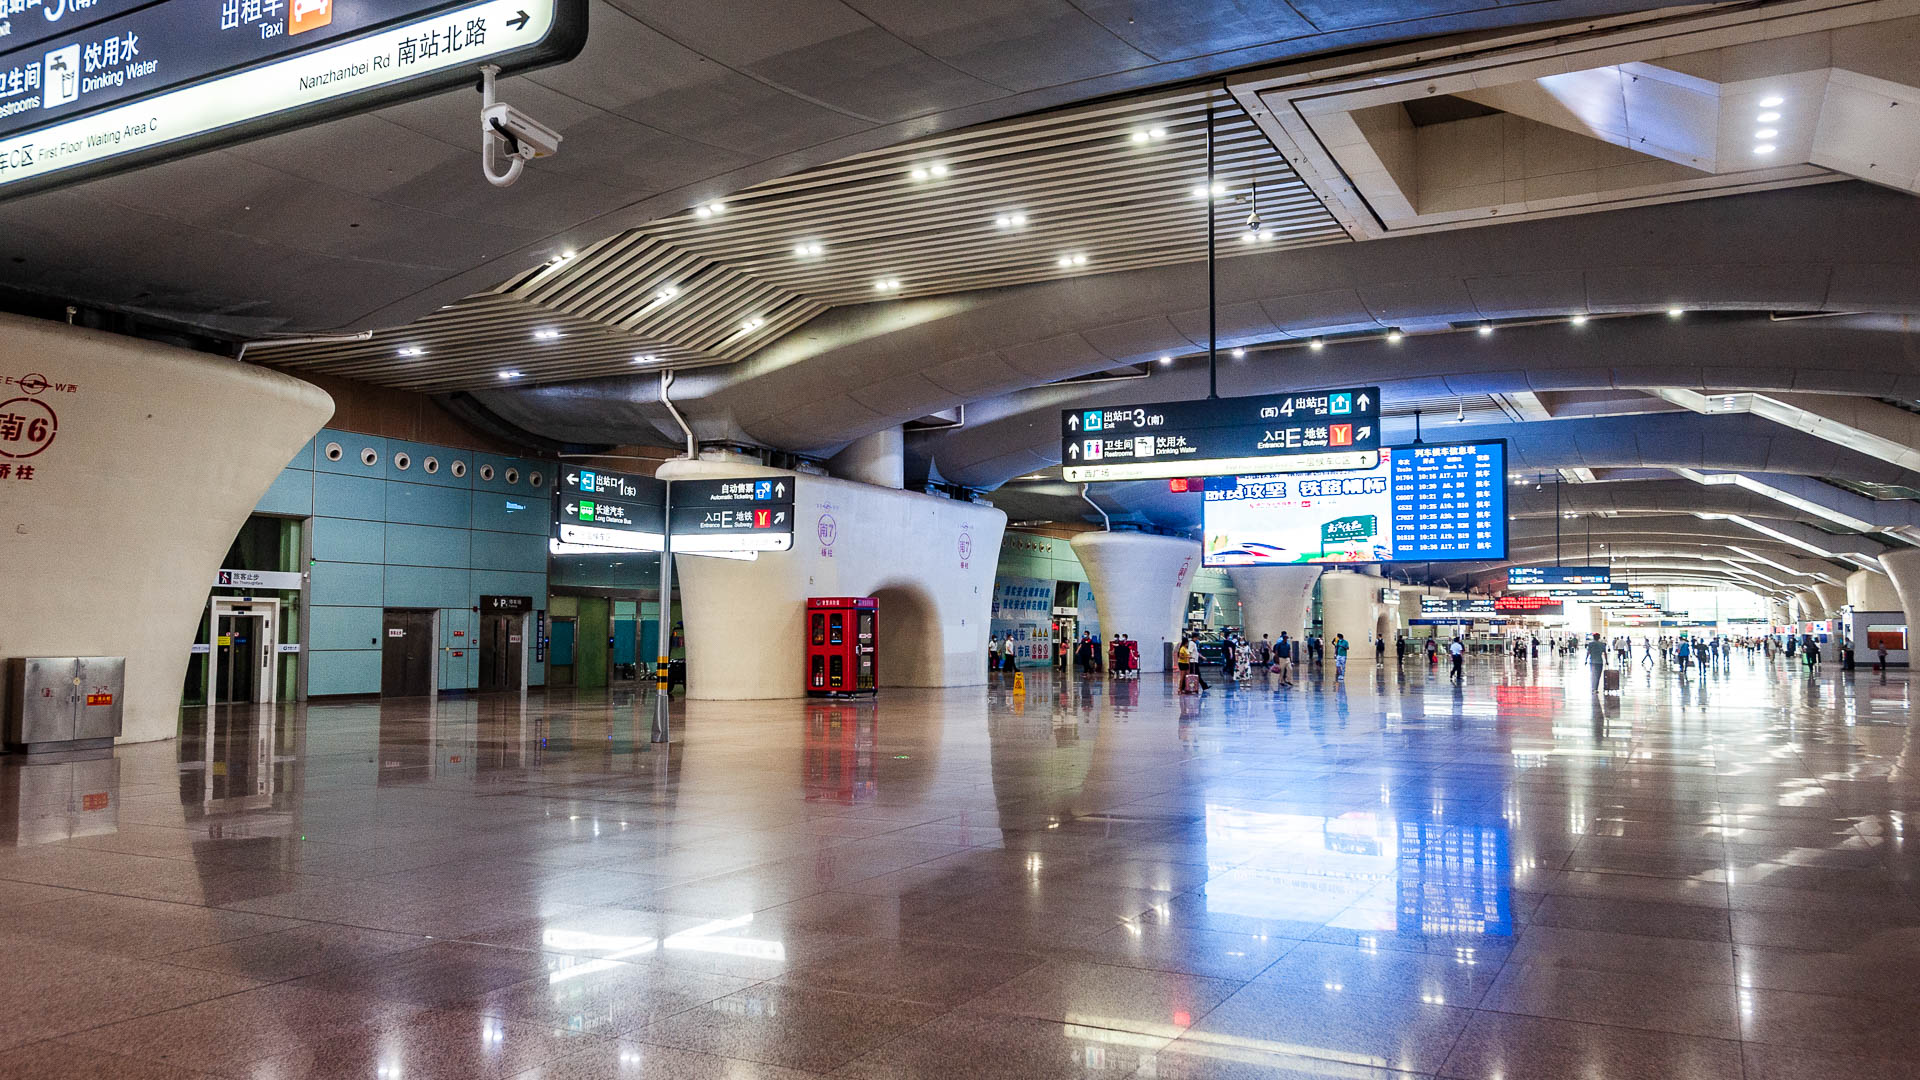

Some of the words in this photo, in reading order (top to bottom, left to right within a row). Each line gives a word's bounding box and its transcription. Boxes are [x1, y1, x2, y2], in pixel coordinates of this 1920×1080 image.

[259, 18, 283, 39] Taxi
[398, 17, 487, 67] 南站北路
[84, 31, 139, 73] 饮用水
[82, 71, 123, 93] Drinking
[126, 60, 158, 80] Water
[300, 60, 369, 91] Nanzhanbei
[373, 54, 390, 71] Rd
[38, 147, 57, 161] First
[60, 140, 83, 156] Floor
[87, 130, 120, 148] Waiting
[123, 125, 146, 139] Area
[150, 117, 158, 131] C
[1304, 427, 1328, 439] 地铁
[1104, 439, 1133, 451] 卫生间
[1156, 436, 1187, 448] 饮用水
[1302, 439, 1328, 447] Subway
[1104, 450, 1133, 458] Restrooms
[1156, 447, 1179, 455] Drinking
[1179, 446, 1197, 454] Water
[721, 483, 754, 494] 自动售票
[595, 503, 625, 517] 长途汽车
[735, 511, 753, 522] 地铁
[734, 521, 753, 529] Subway
